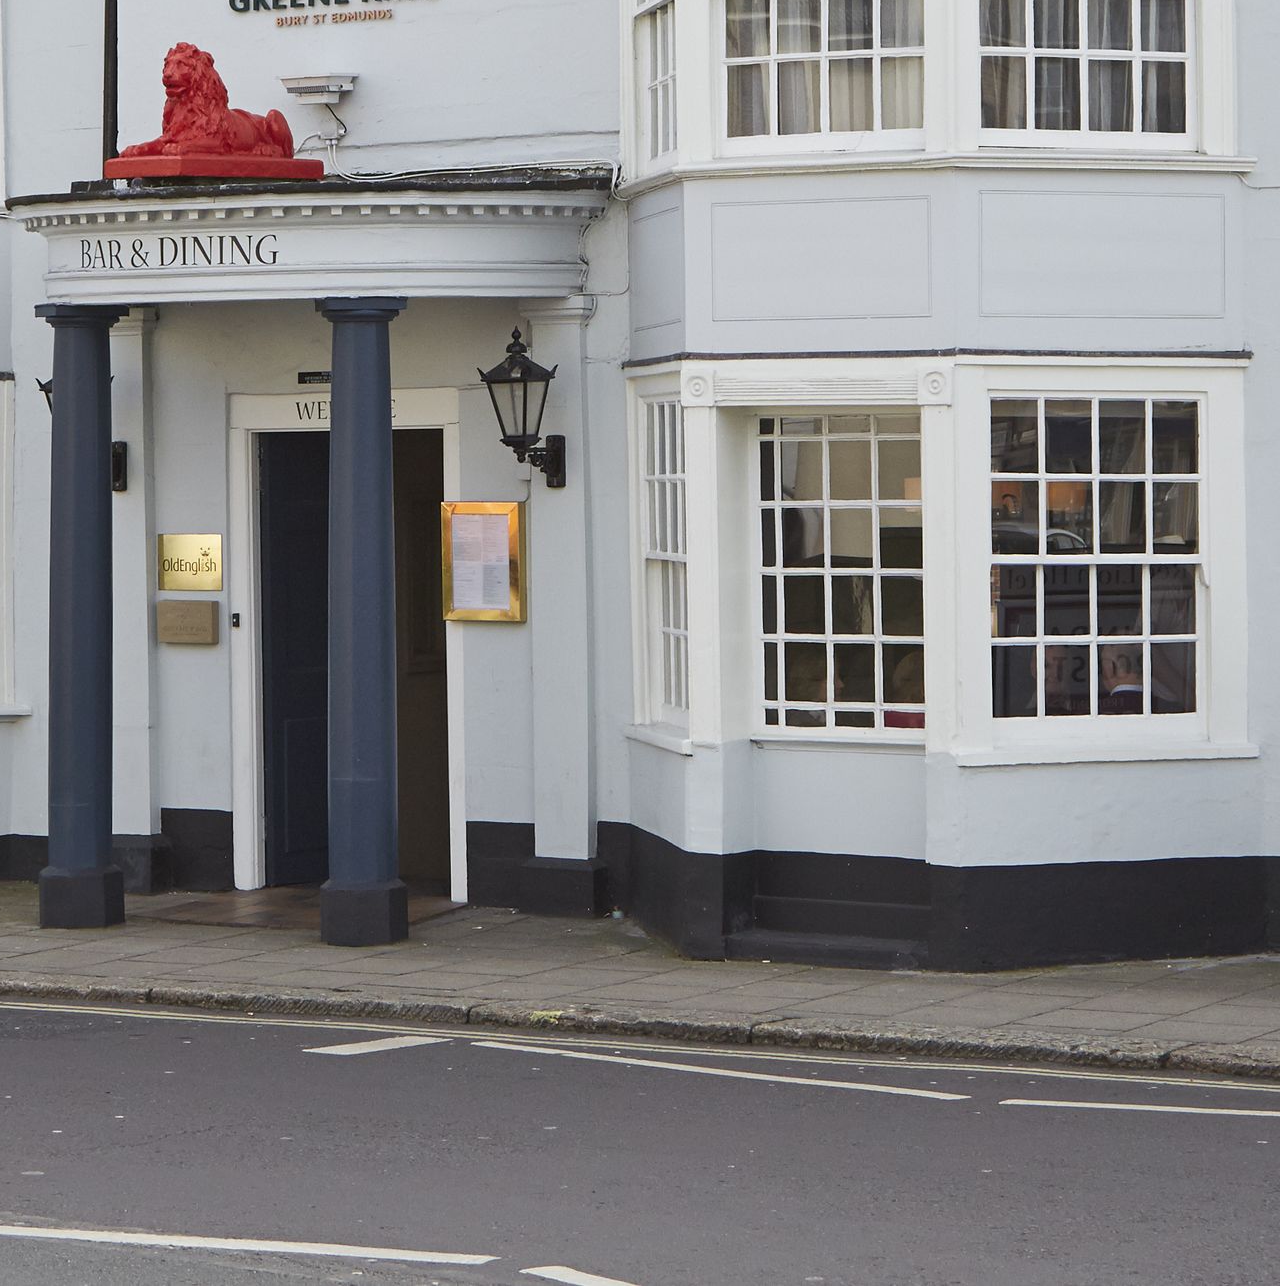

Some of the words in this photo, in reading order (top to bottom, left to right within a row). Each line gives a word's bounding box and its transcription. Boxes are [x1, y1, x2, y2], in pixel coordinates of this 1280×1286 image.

[275, 14, 308, 28] BURY
[312, 13, 327, 25] ST
[331, 8, 394, 23] EDMUNDS
[80, 239, 123, 269] BAR
[130, 238, 150, 268] &
[157, 234, 279, 267] DINING
